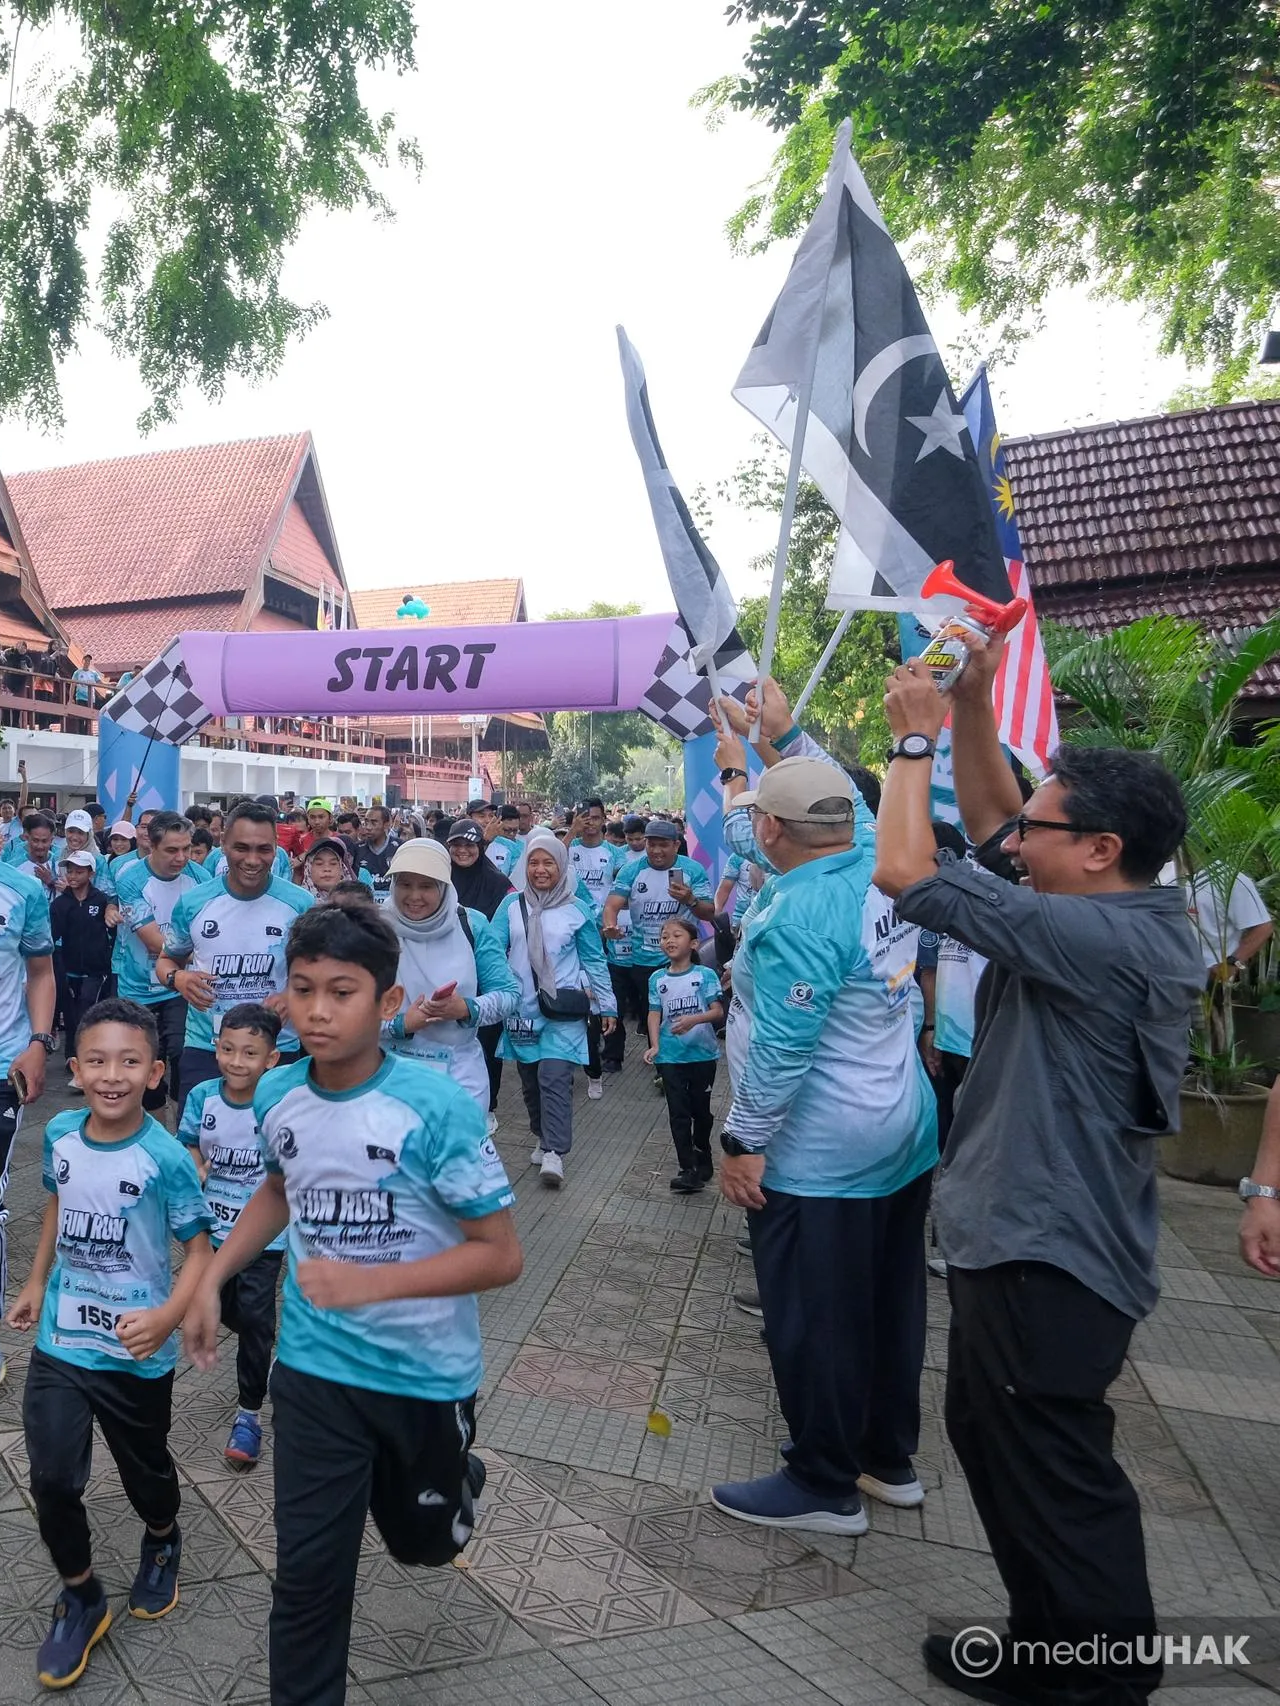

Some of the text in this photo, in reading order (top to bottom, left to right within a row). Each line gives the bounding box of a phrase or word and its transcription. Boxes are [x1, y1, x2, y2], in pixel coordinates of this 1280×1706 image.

[327, 643, 496, 693] START
[88, 905, 99, 914] 23
[644, 901, 680, 914] FUN RUN
[211, 954, 275, 978] FUN RUN
[232, 1148, 261, 1167] RUN
[299, 1188, 395, 1226] FUN RUN
[62, 1208, 128, 1246] FUN RUN
